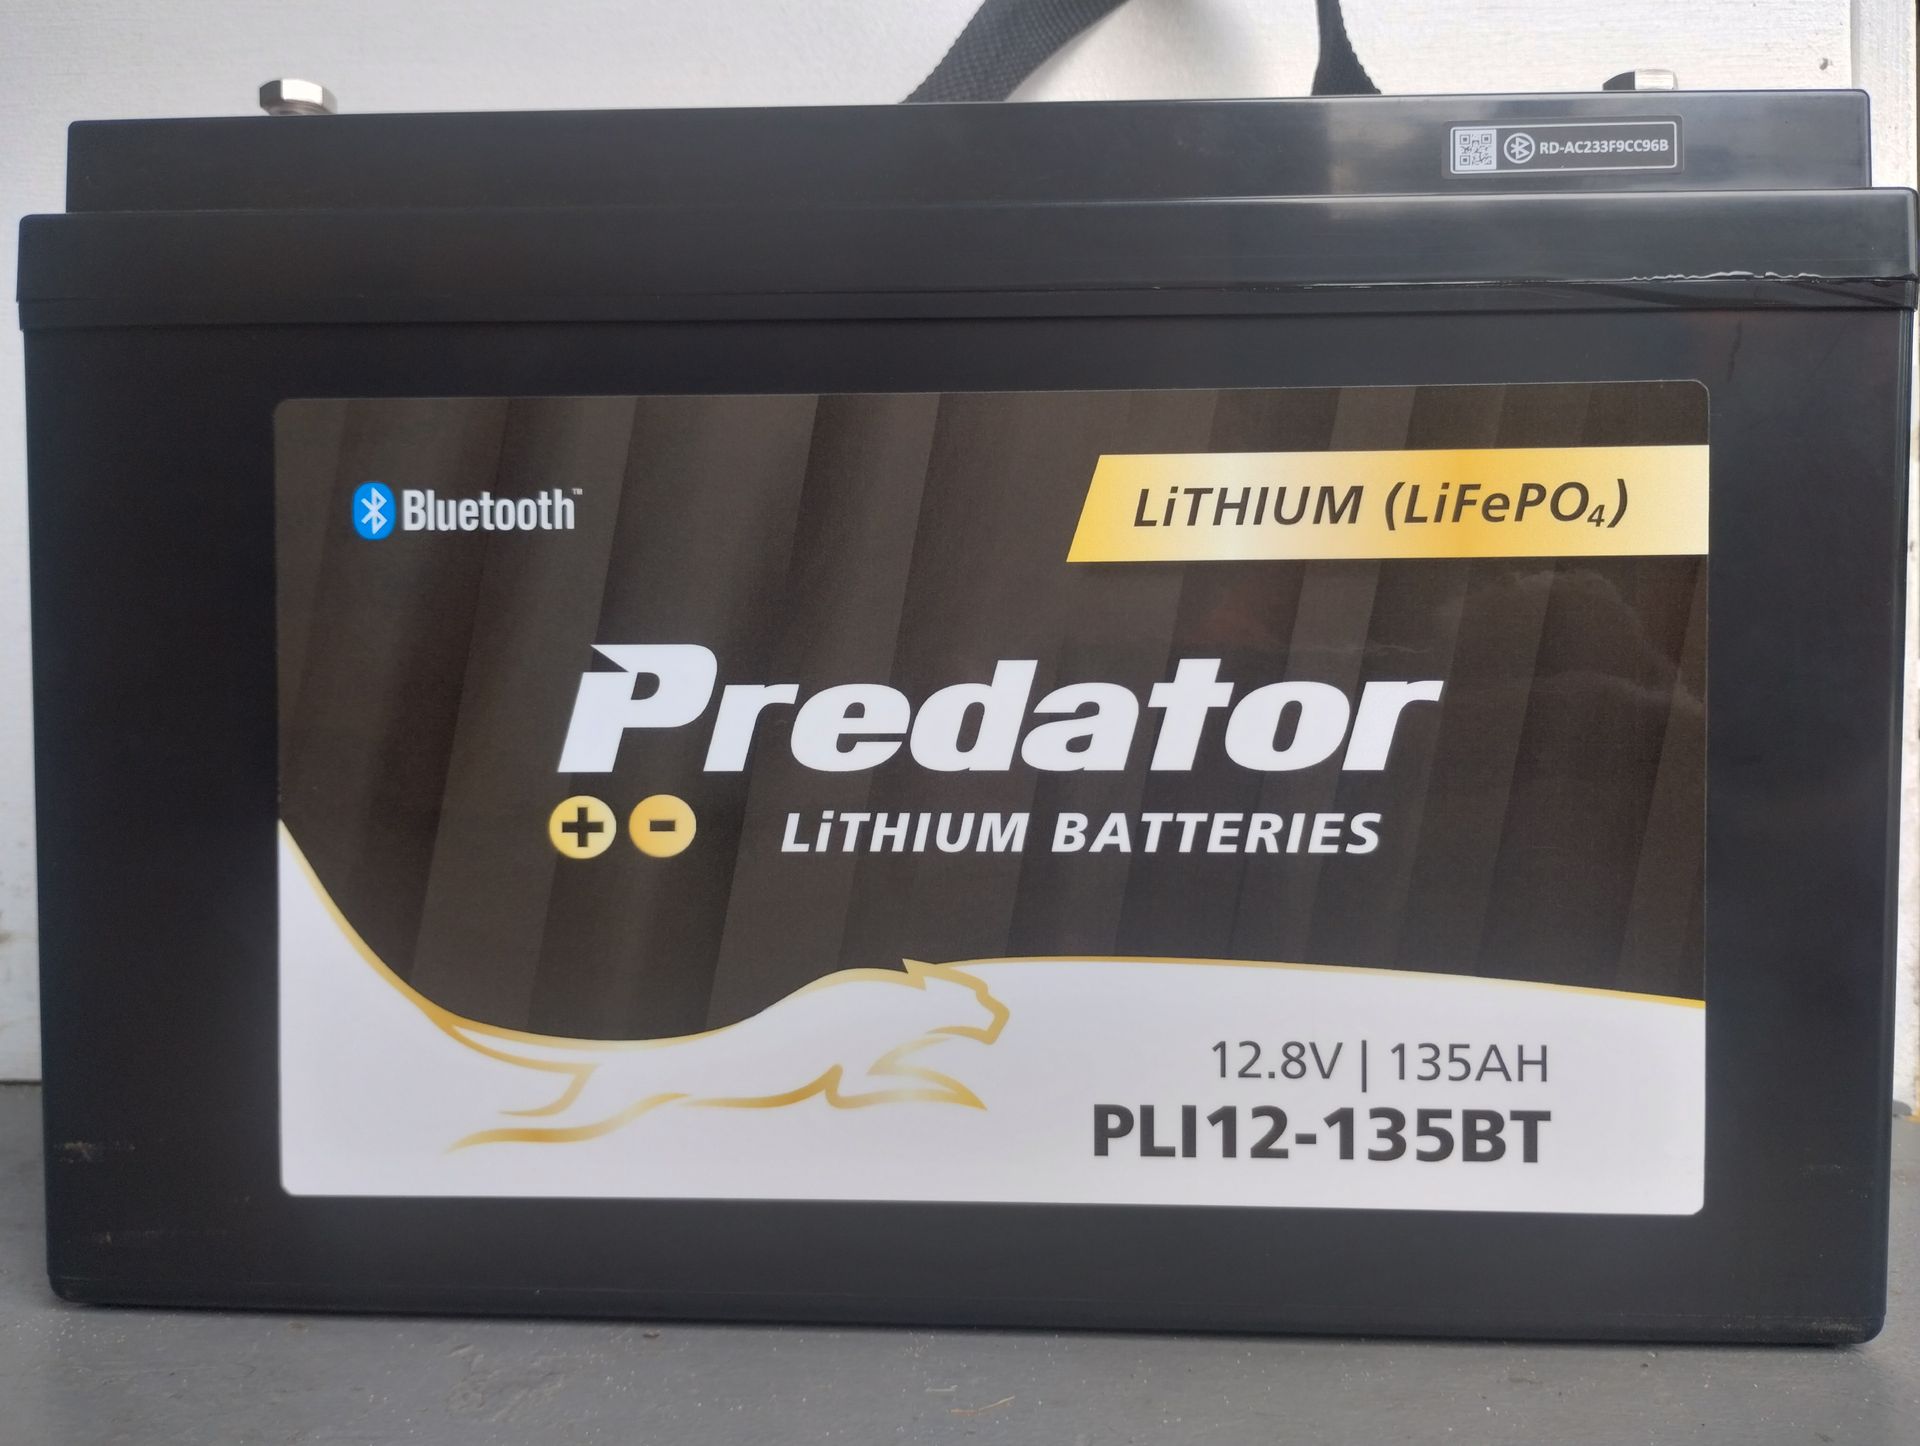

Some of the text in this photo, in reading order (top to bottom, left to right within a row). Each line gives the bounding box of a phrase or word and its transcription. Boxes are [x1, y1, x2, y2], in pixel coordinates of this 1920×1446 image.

[1539, 139, 1669, 155] RD-AC233F9CC96B
[402, 488, 575, 532] Bluetooth
[1133, 484, 1365, 528] LiTHIUM
[557, 643, 1444, 773] Predator
[780, 811, 1382, 855] LiTHIUM BATTERIES
[1211, 1040, 1343, 1080] 12.8V
[1390, 1043, 1548, 1083] 135AH
[1093, 1103, 1551, 1163] PLI12-135BT
